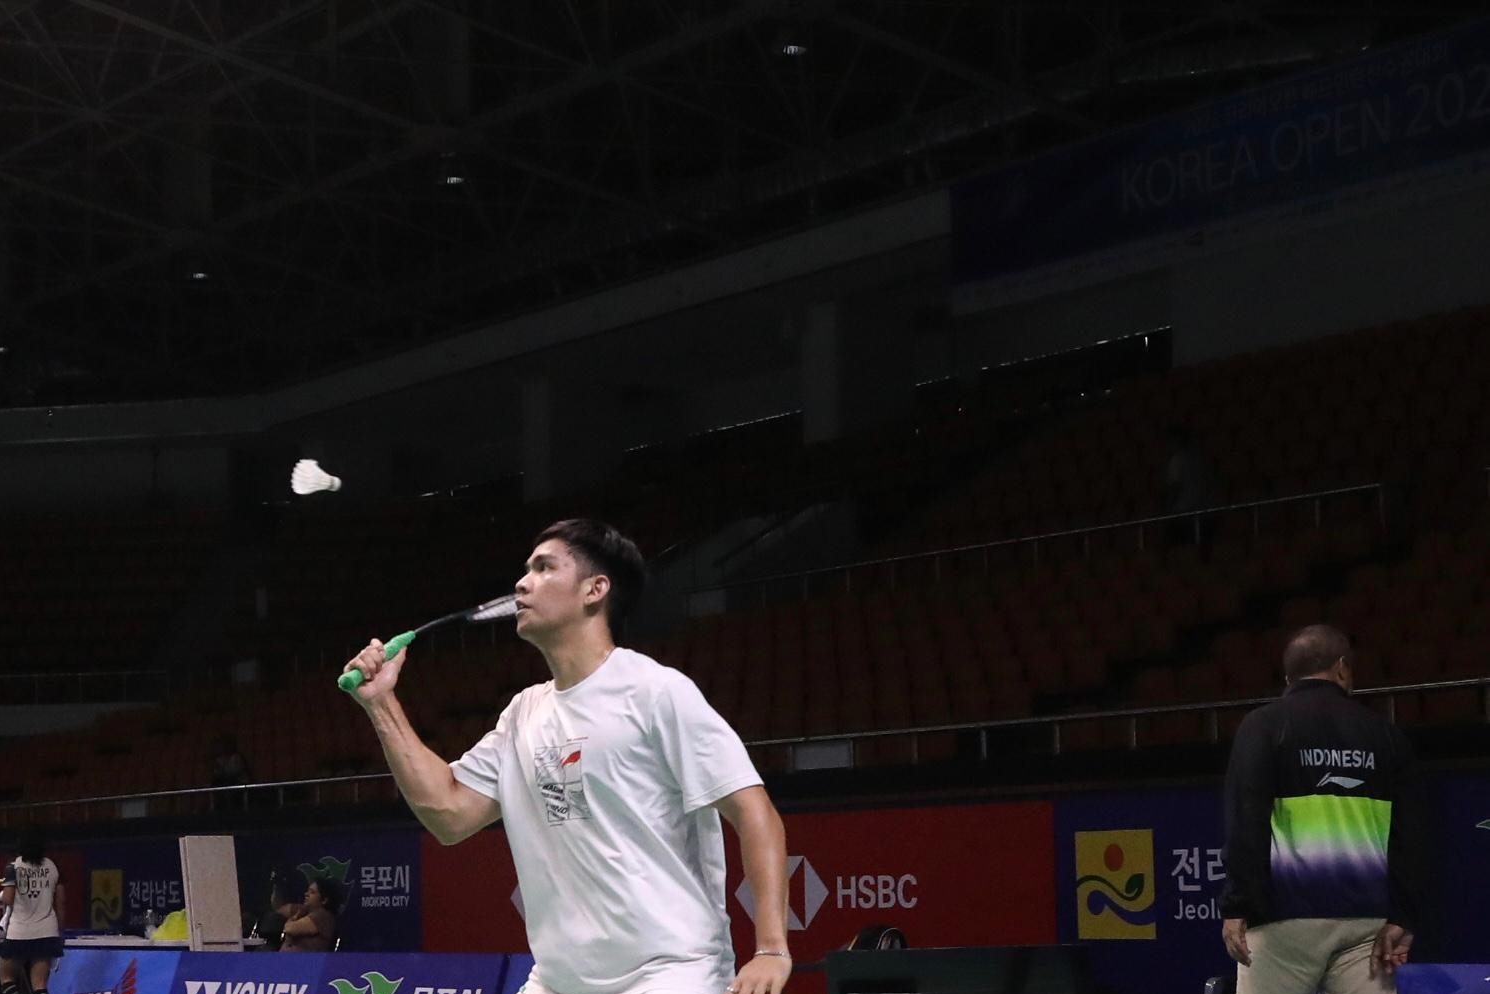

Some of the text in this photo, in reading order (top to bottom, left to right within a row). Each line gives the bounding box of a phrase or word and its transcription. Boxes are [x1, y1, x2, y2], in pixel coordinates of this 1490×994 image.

[1119, 136, 1260, 213] KOREA
[1268, 94, 1392, 174] OPEN
[1300, 748, 1375, 770] INDONESIA
[360, 865, 410, 894] 목포시
[836, 874, 919, 909] HSBC
[128, 880, 182, 908] 전라남도
[362, 895, 410, 907] MOKPO CITY
[1173, 897, 1221, 919] Jeol
